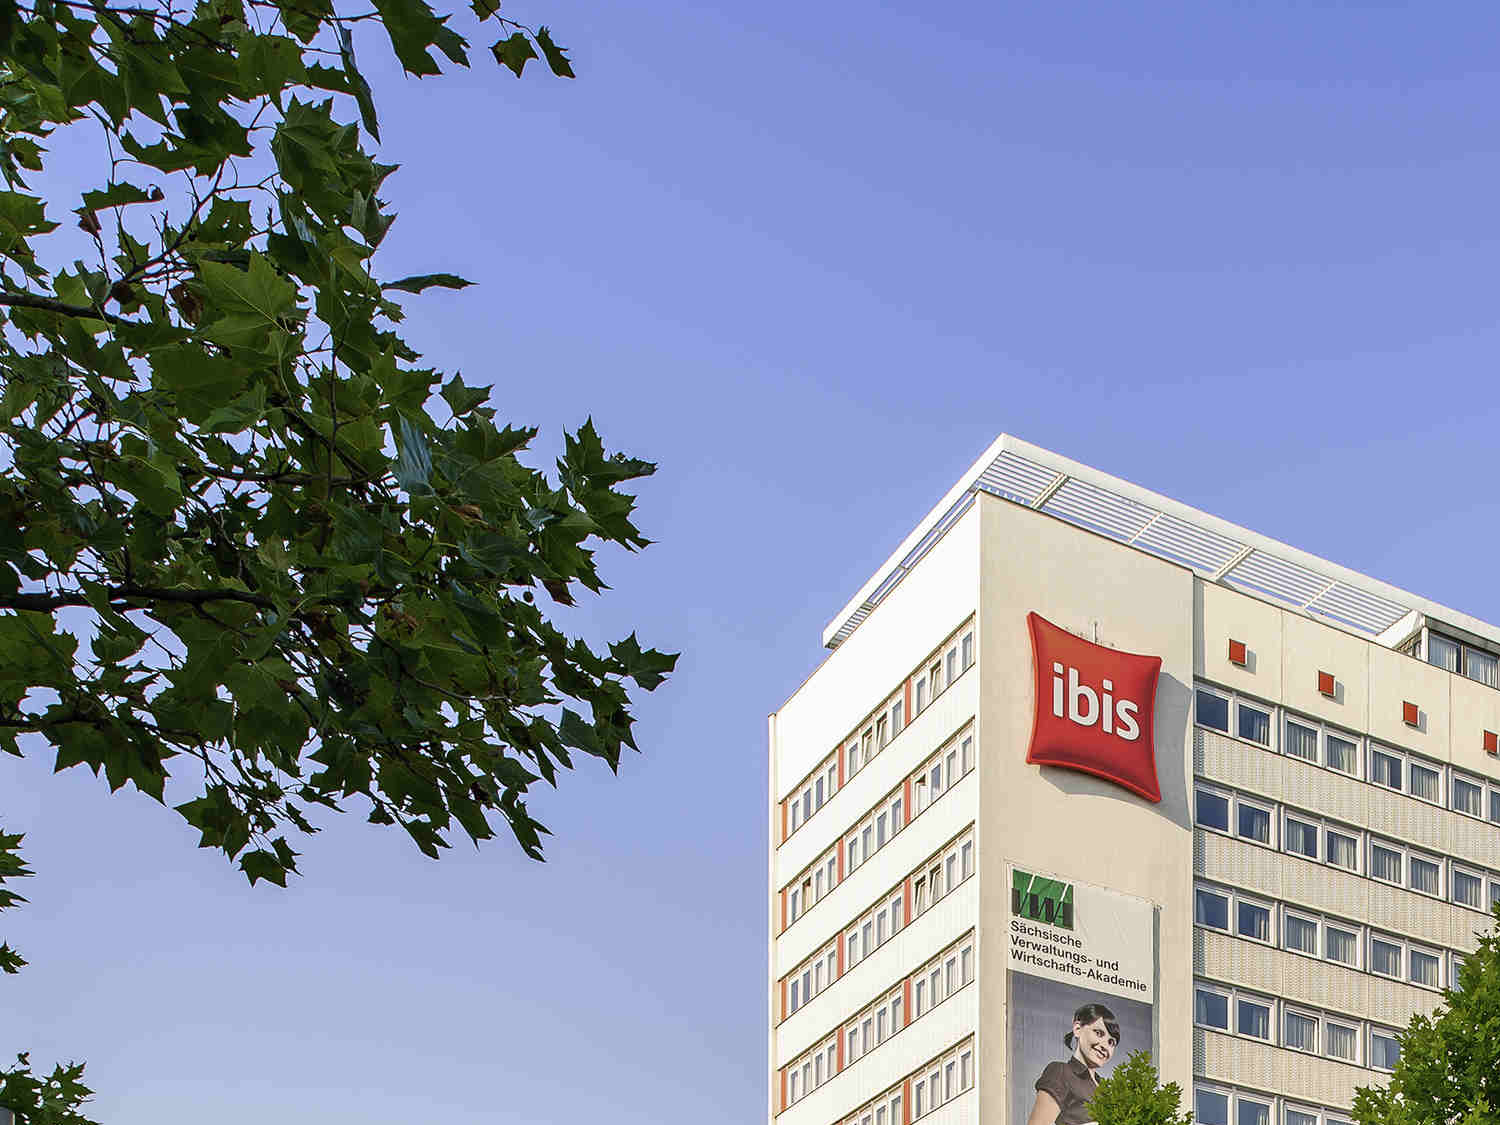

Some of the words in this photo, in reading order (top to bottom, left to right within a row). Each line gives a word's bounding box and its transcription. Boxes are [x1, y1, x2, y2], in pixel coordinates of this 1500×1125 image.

[1053, 661, 1140, 741] ibis
[1010, 920, 1082, 949] Sächsische
[1010, 934, 1092, 964] Verwaltungs-
[1096, 958, 1119, 971] und
[1010, 949, 1147, 992] Wirtschafts-Akademie
